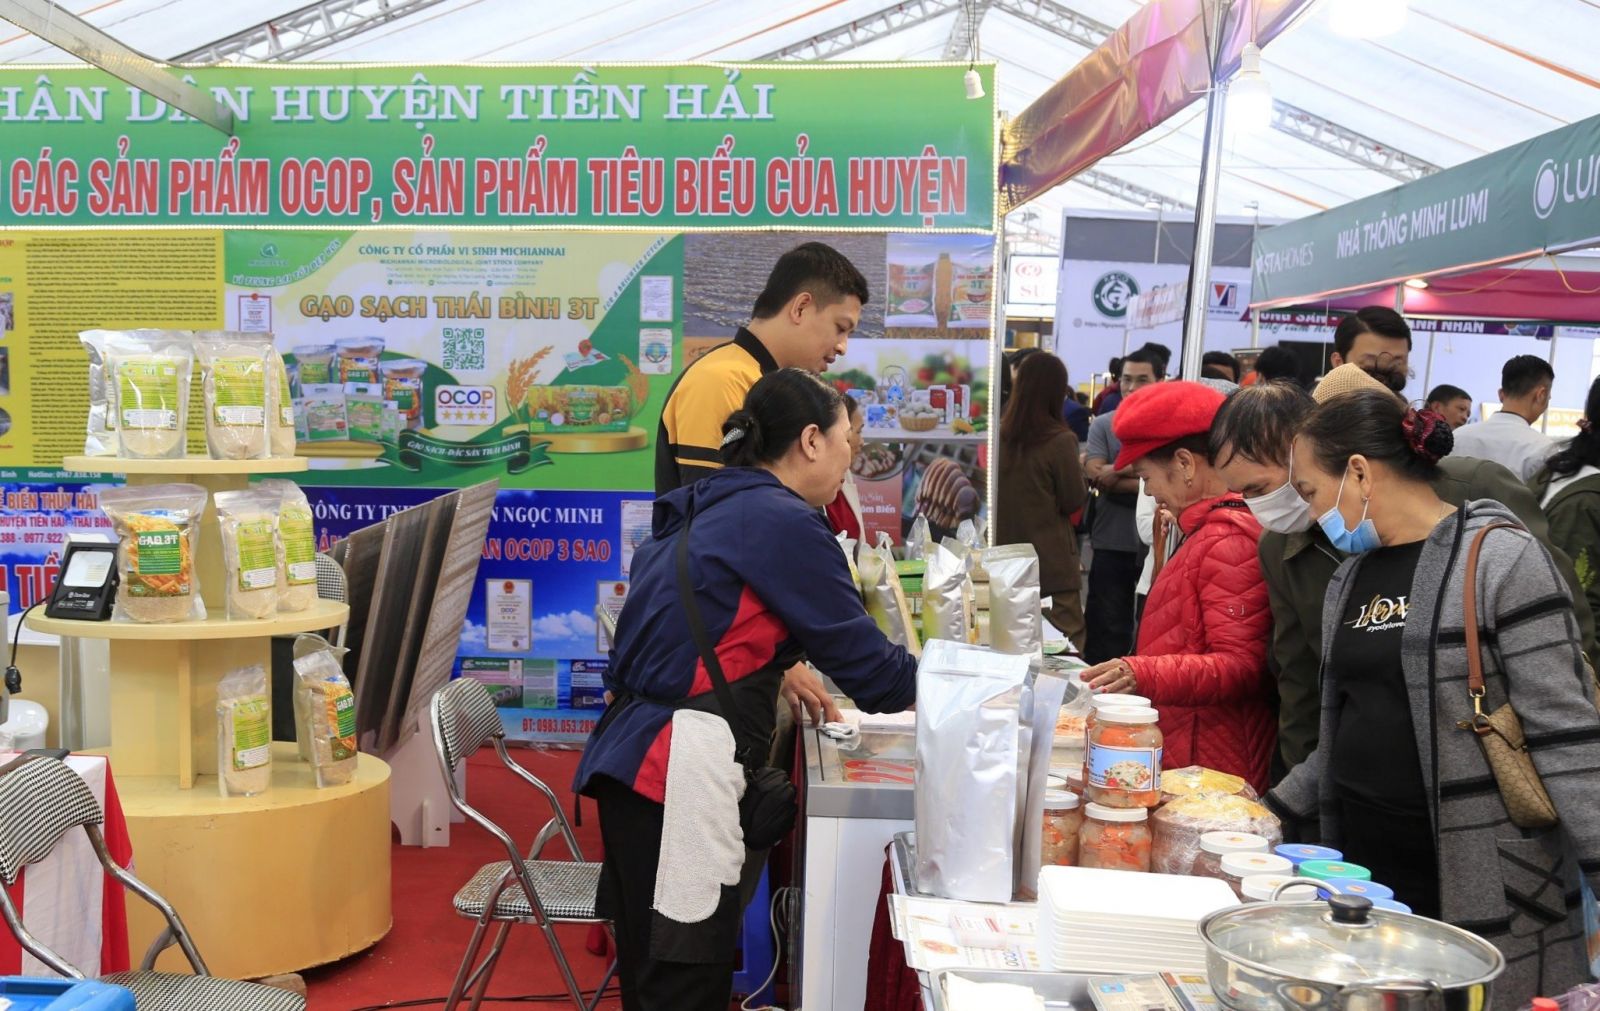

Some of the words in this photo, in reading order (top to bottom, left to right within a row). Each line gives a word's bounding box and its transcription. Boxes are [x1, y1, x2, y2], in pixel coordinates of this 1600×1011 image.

[271, 72, 483, 130] HUYỆN
[500, 67, 645, 121] TIỀN
[664, 69, 774, 120] HẢI
[10, 147, 78, 216] CÁC
[88, 135, 158, 216] SẢN
[168, 136, 270, 216] PHẨM
[280, 158, 382, 223] OCOP,
[392, 134, 465, 215] SẢN
[474, 135, 578, 216] PHẨM
[587, 146, 662, 216] TIÊU
[675, 135, 756, 216] BIỂU
[766, 133, 839, 216] CỦA
[849, 144, 967, 227] HUYỆN
[1337, 220, 1360, 259] NHÀ
[1363, 211, 1408, 249] THÔNG
[1410, 201, 1448, 241] MINH
[1450, 188, 1489, 231] LUMI
[359, 244, 389, 256] CÔNG
[393, 247, 406, 256] TY
[458, 247, 469, 256] VI
[472, 247, 497, 256] SINH
[500, 247, 565, 257] MICHIANNAI
[300, 295, 353, 322] GẠO
[360, 295, 428, 323] SẠCH
[433, 291, 492, 319] THÁI
[499, 291, 561, 319] BÌNH
[568, 297, 599, 319] 3T
[438, 390, 493, 405] OCOP
[311, 500, 351, 519] ÔNG
[354, 504, 376, 520] TY
[503, 506, 551, 528] NGỌC
[555, 508, 603, 523] MINH
[505, 538, 554, 561] OCOP
[558, 539, 569, 561] 3
[573, 539, 611, 562] SAO
